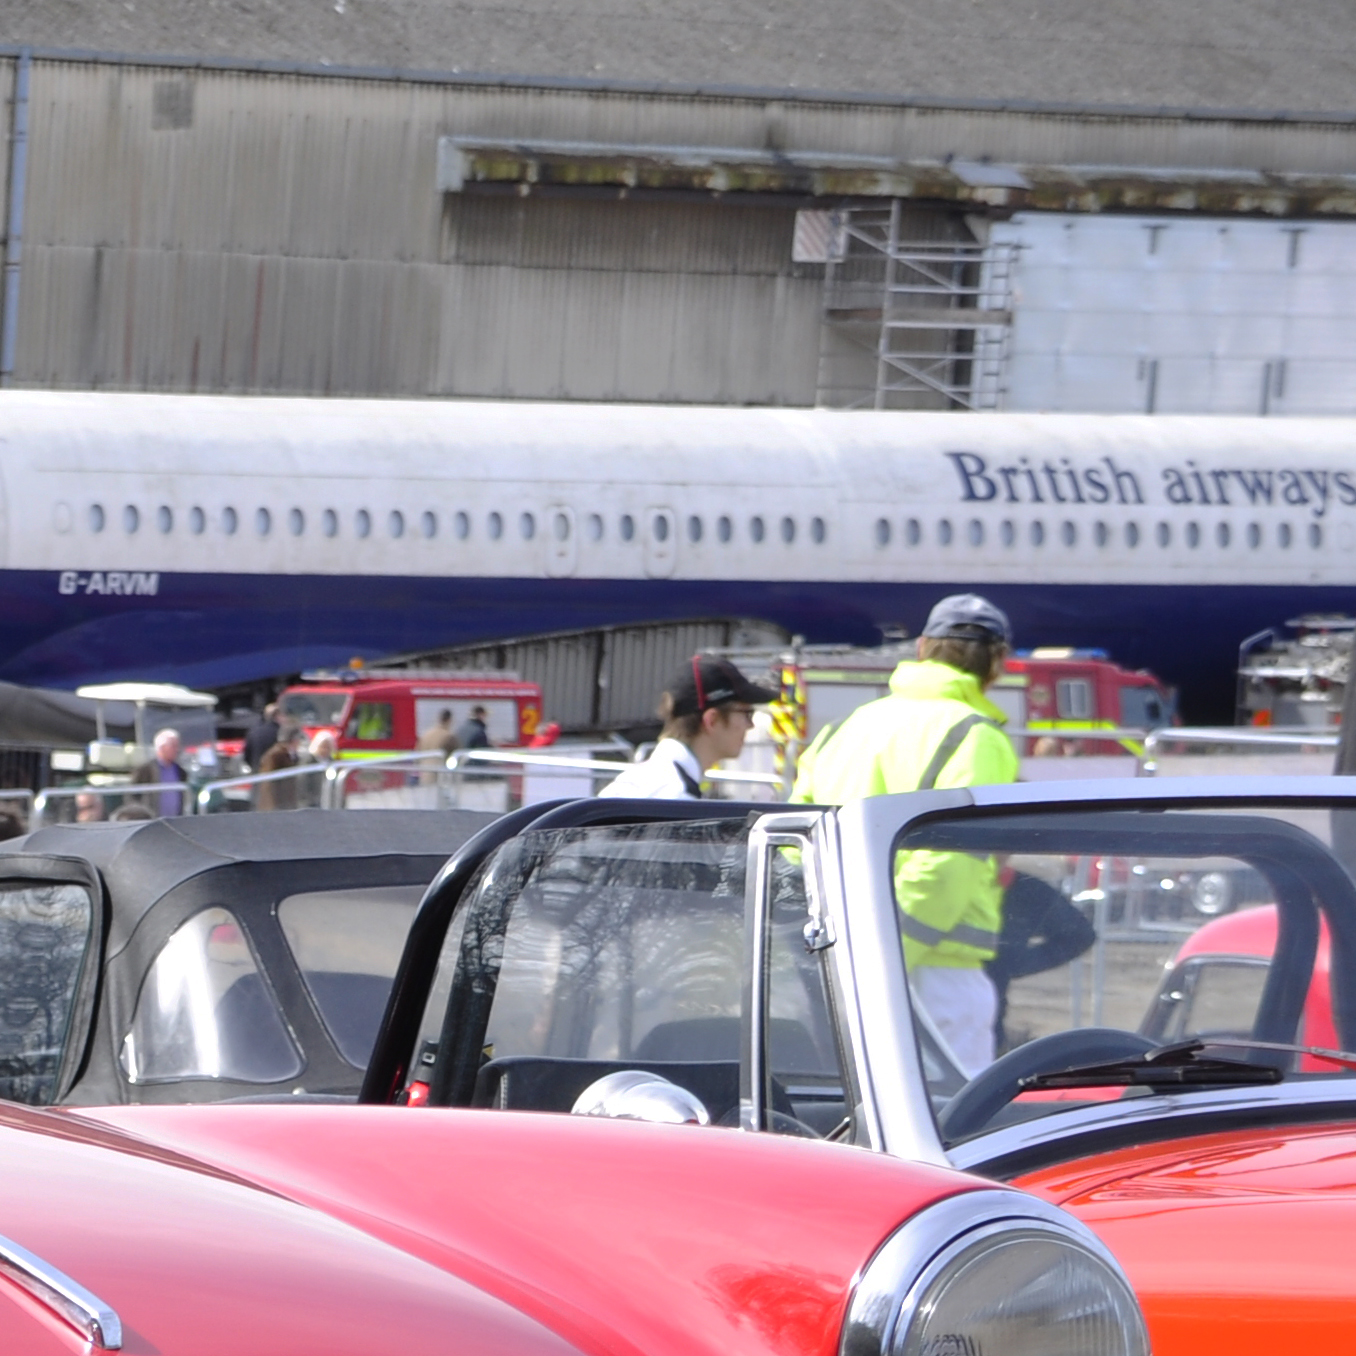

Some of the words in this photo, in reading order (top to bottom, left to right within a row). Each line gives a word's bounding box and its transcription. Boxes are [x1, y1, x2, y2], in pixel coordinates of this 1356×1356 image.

[946, 451, 1146, 506] British
[1161, 460, 1356, 518] airways
[58, 571, 159, 597] G-ARVM
[521, 707, 539, 736] 2
